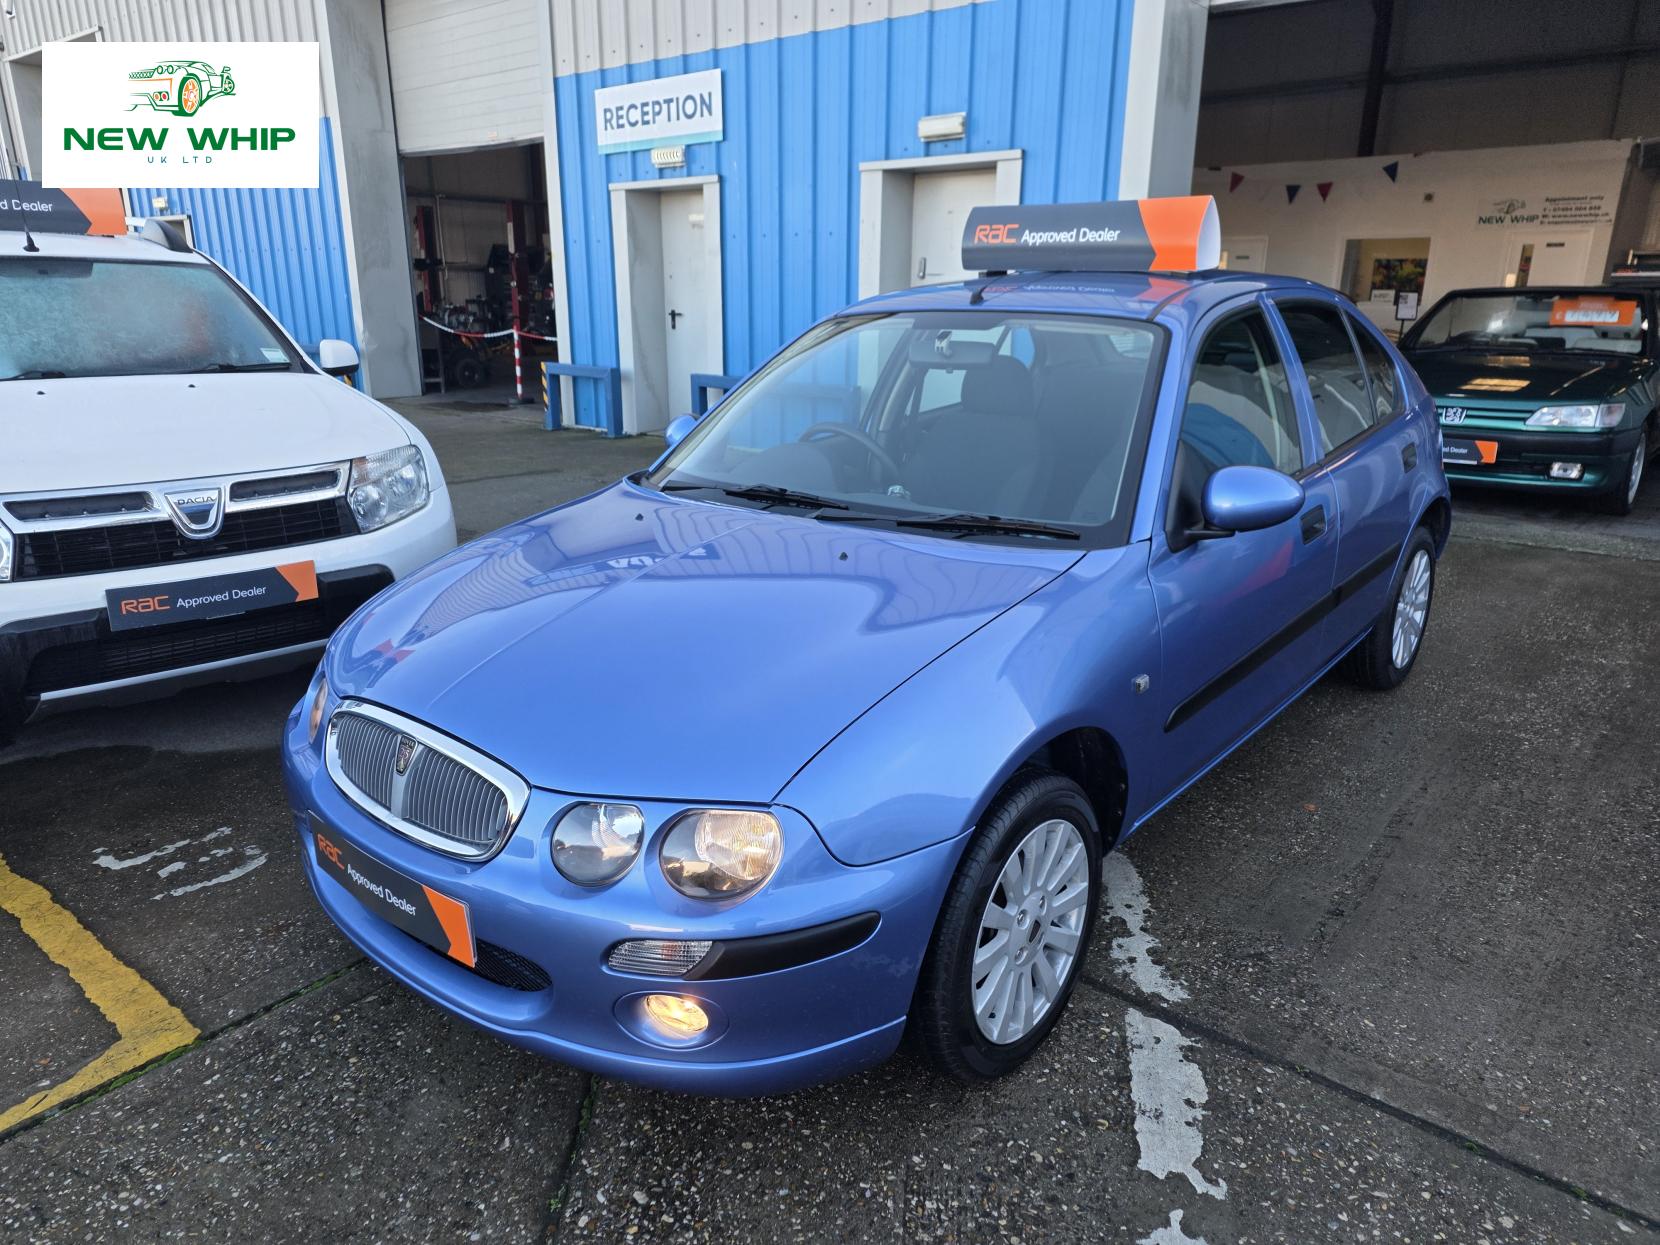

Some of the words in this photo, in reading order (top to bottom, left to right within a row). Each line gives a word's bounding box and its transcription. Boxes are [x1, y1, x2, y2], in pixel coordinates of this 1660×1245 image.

[603, 91, 713, 131] RECEPTION
[11, 199, 53, 212] Dealer
[1478, 215, 1506, 225] NEW
[1510, 214, 1539, 224] WHIP
[1020, 228, 1076, 246] Approved
[1078, 227, 1121, 243] Dealer
[177, 495, 214, 505] DACIA
[176, 592, 229, 608] Approved
[232, 585, 267, 599] Dealer
[347, 863, 384, 898] Approved
[384, 888, 417, 916] Dealer
